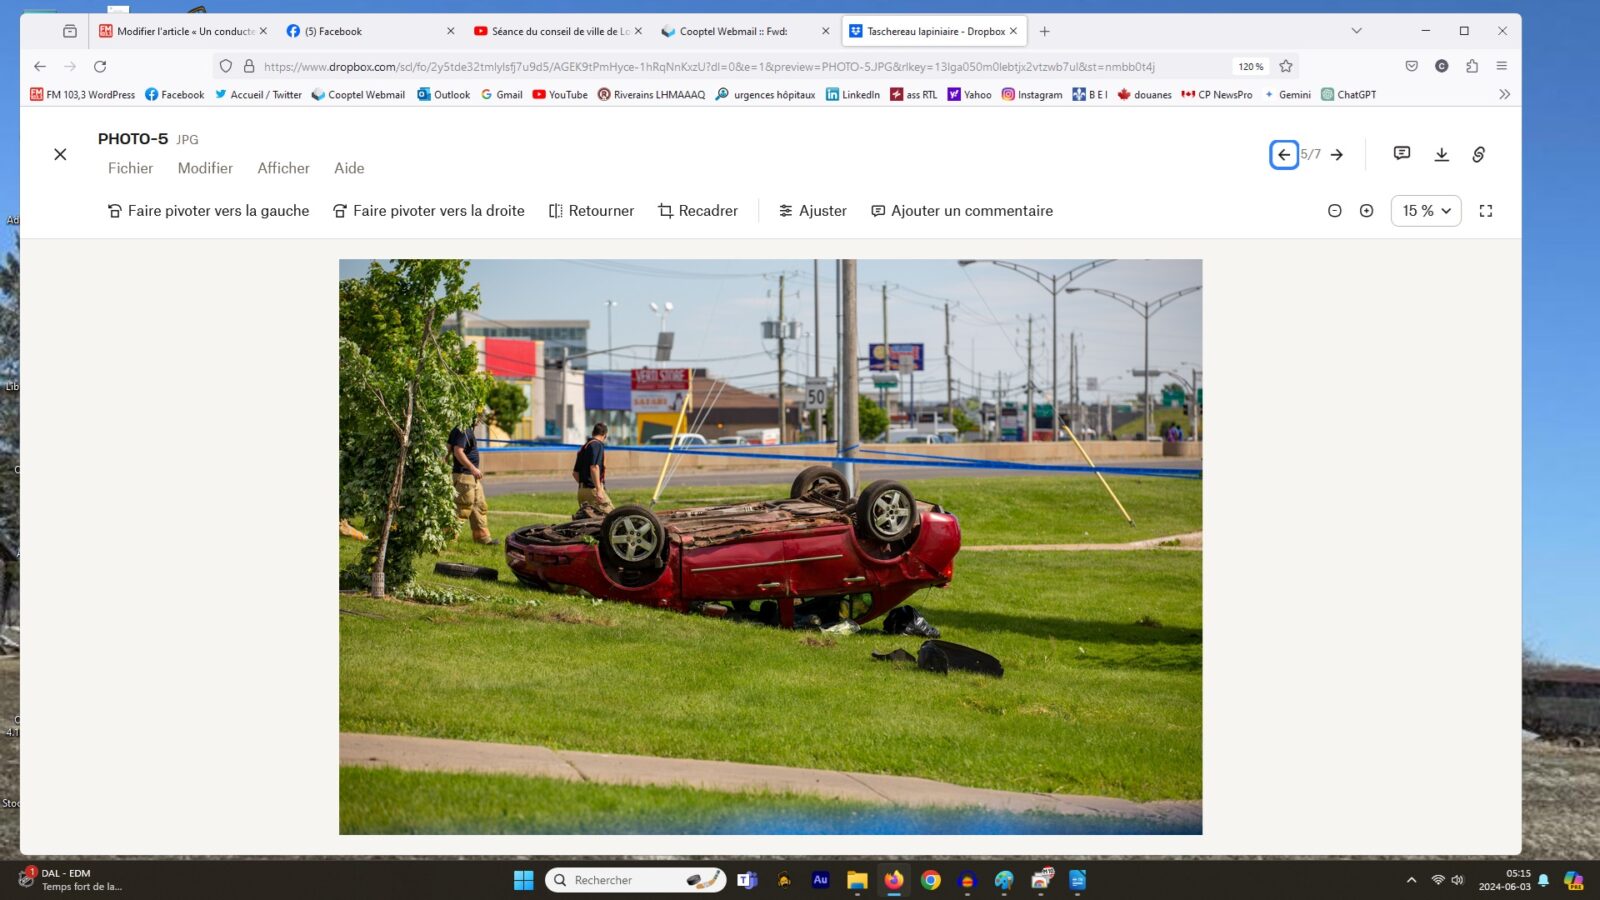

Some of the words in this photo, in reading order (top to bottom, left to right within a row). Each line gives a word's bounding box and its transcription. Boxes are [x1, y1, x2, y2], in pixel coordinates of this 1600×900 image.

[117, 26, 156, 36] Modifier
[157, 26, 190, 36] l'article
[199, 26, 212, 36] Un
[305, 26, 317, 38] (5)
[319, 26, 363, 36] Facebook
[492, 26, 524, 36] Séance
[525, 26, 538, 36] du
[539, 26, 571, 36] conseil
[573, 26, 585, 36] de
[586, 26, 605, 36] ville
[606, 26, 618, 36] de
[680, 26, 715, 38] Cooptel
[717, 26, 757, 36] Webmail
[766, 26, 788, 36] Fwd:
[867, 26, 917, 36] Taschereau
[918, 26, 960, 38] lapiniaire
[967, 26, 1006, 38] Dropbox
[1238, 62, 1255, 71] 120
[1255, 62, 1265, 71] %
[46, 90, 61, 100] FM
[63, 90, 87, 101] 103,3
[87, 90, 136, 100] WordPress
[161, 90, 205, 100] Facebook
[230, 90, 264, 100] Accueil
[272, 90, 303, 100] Twitter
[328, 90, 364, 101] Cooptel
[365, 90, 406, 100] Webmail
[433, 90, 471, 100] Outlook
[496, 90, 524, 100] Gmail
[548, 90, 589, 100] YouTube
[613, 90, 654, 100] Riverains
[655, 90, 707, 101] LHMAAAQ
[734, 92, 775, 101] urgences
[776, 90, 816, 101] hôpitaux
[842, 90, 881, 100] LinkedIn
[906, 92, 921, 100] ass
[922, 90, 938, 100] RTL
[963, 90, 993, 100] Yahoo
[1018, 90, 1064, 101] Instagram
[1134, 90, 1173, 100] douanes
[1198, 90, 1212, 100] CP
[1213, 90, 1254, 100] NewsPro
[1279, 90, 1312, 100] Gemini
[1337, 90, 1377, 100] ChatGPT
[98, 132, 169, 146] PHOTO-5
[175, 133, 200, 147] JPG
[1300, 148, 1322, 161] 5/7
[108, 161, 155, 176] Fichier
[178, 161, 234, 176] Modifier
[257, 161, 311, 176] Afficher
[333, 161, 365, 176] Aide
[127, 203, 162, 218] Faire
[165, 203, 212, 221] pivoter
[215, 206, 243, 218] vers
[245, 203, 258, 218] la
[260, 203, 311, 221] gauche
[352, 203, 388, 218] Faire
[390, 203, 437, 221] pivoter
[439, 206, 468, 218] vers
[470, 203, 483, 218] la
[485, 203, 526, 218] droite
[568, 203, 636, 218] Retourner
[678, 203, 739, 218] Recadrer
[798, 203, 848, 221] Ajuster
[890, 203, 941, 221] Ajouter
[944, 206, 961, 218] un
[964, 203, 1054, 218] commentaire
[1402, 204, 1418, 217] 15
[1420, 204, 1435, 218] %
[808, 388, 825, 405] 50
[41, 869, 60, 878] DAL
[69, 869, 91, 878] EDM
[813, 874, 829, 884] Au
[1506, 869, 1532, 878] 05:15
[574, 873, 633, 886] Rechercher
[41, 882, 72, 893] Temps
[73, 881, 91, 891] fort
[92, 881, 105, 891] de
[106, 881, 123, 891] la...
[1478, 882, 1532, 891] 2024-06-03
